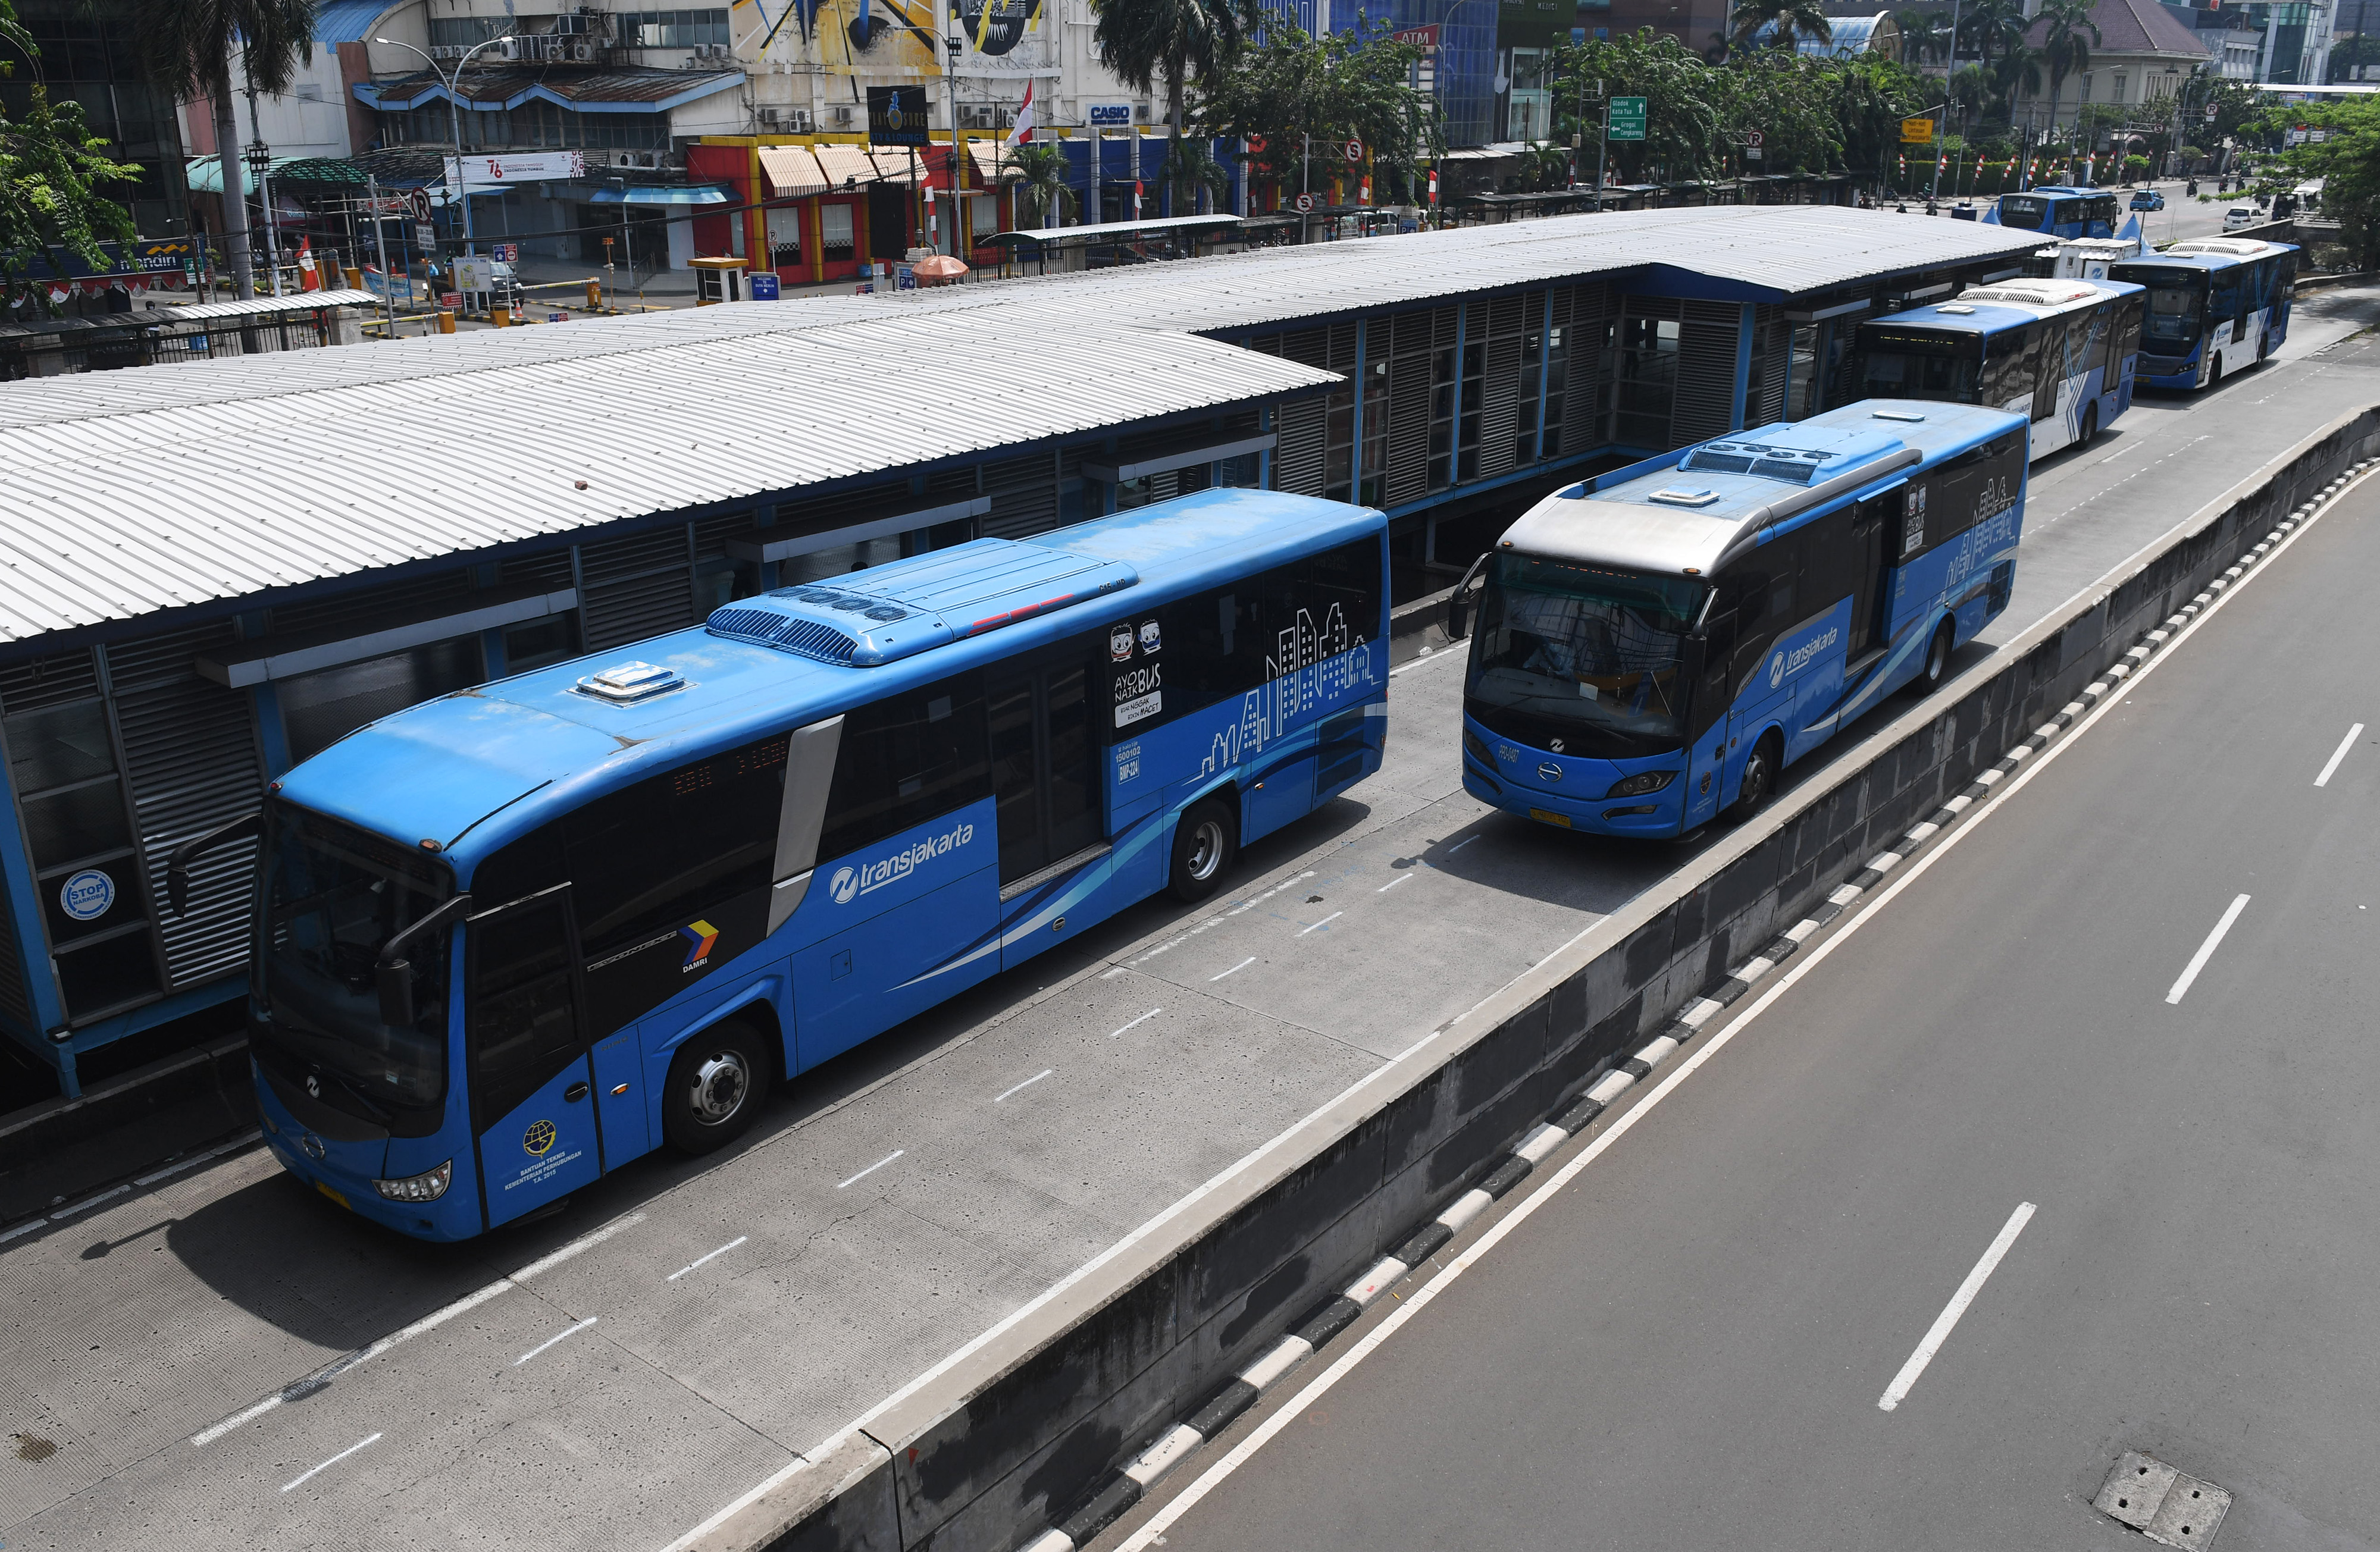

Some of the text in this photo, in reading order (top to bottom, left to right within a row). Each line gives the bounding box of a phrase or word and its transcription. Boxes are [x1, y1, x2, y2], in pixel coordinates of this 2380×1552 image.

[1402, 32, 1429, 45] ATM
[1091, 106, 1129, 119] CASIO
[892, 133, 925, 142] LOUNGE
[487, 159, 502, 178] 76
[1785, 627, 1837, 676] transjakarta
[1114, 671, 1137, 691] AYO
[1138, 663, 1161, 693] BUS
[1115, 684, 1138, 703] NAIK
[1128, 703, 1159, 720] BIKIN MACET
[1130, 697, 1150, 710] NGGAK
[1116, 746, 1141, 763] 1500102
[1120, 760, 1138, 781] BMP-224
[859, 824, 973, 896] transjakarta
[71, 883, 104, 900] STOP
[73, 893, 105, 905] NARKOBA
[683, 957, 707, 973] DAMRI
[505, 1150, 582, 1191] KEMENTERIAN PERHUBUNGAN
[520, 1151, 566, 1177] BANTUAN TEKNIS
[543, 1169, 556, 1179] 2015
